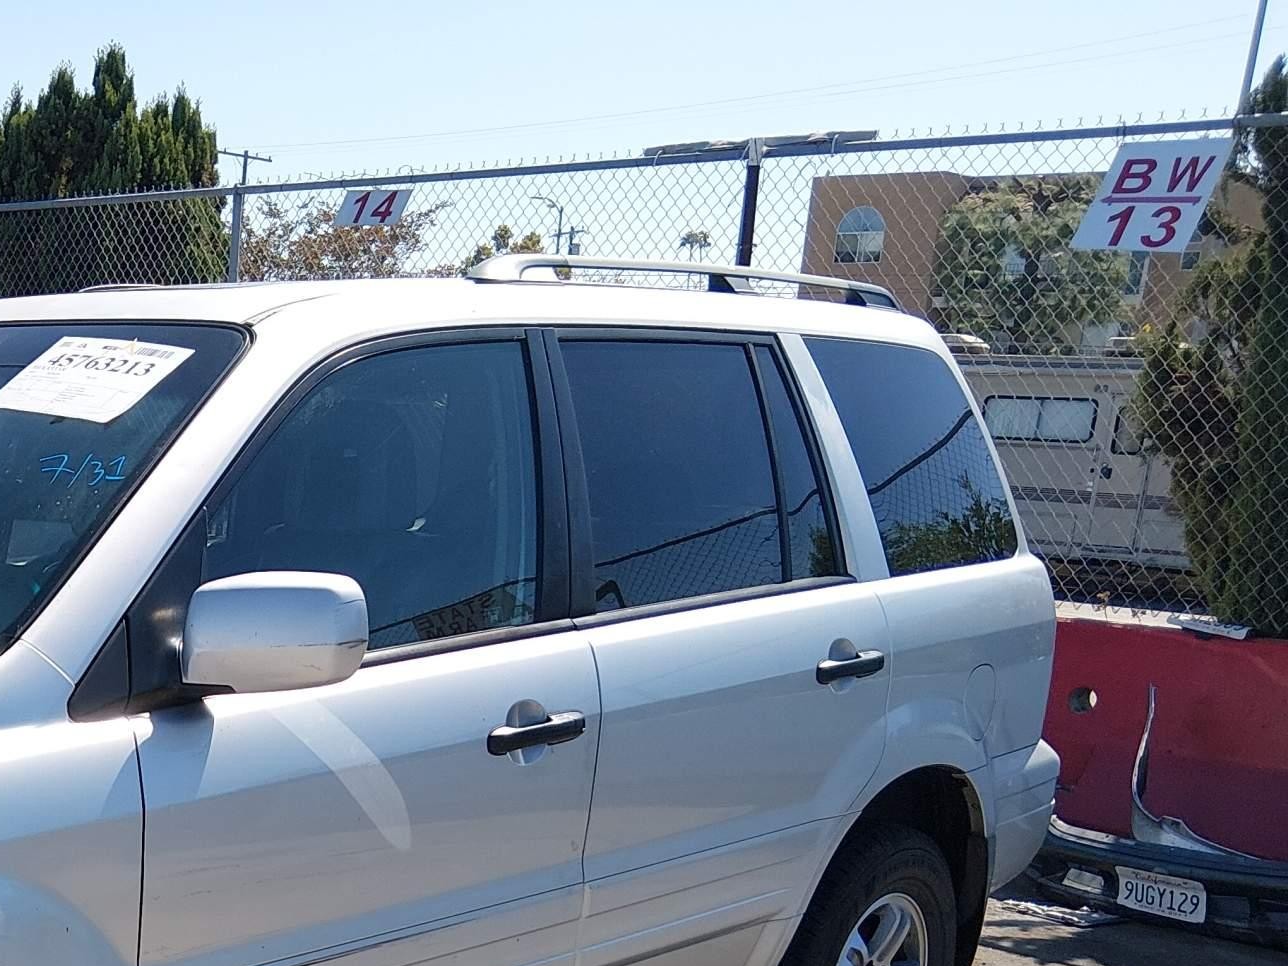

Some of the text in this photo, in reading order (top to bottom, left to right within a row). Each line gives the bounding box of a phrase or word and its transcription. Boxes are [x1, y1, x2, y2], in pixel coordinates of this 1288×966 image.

[353, 191, 398, 223] 14
[1106, 206, 1182, 248] 13
[47, 353, 156, 377] 45763213
[39, 453, 126, 488] 7/31
[1124, 880, 1200, 916] 9UGY129
